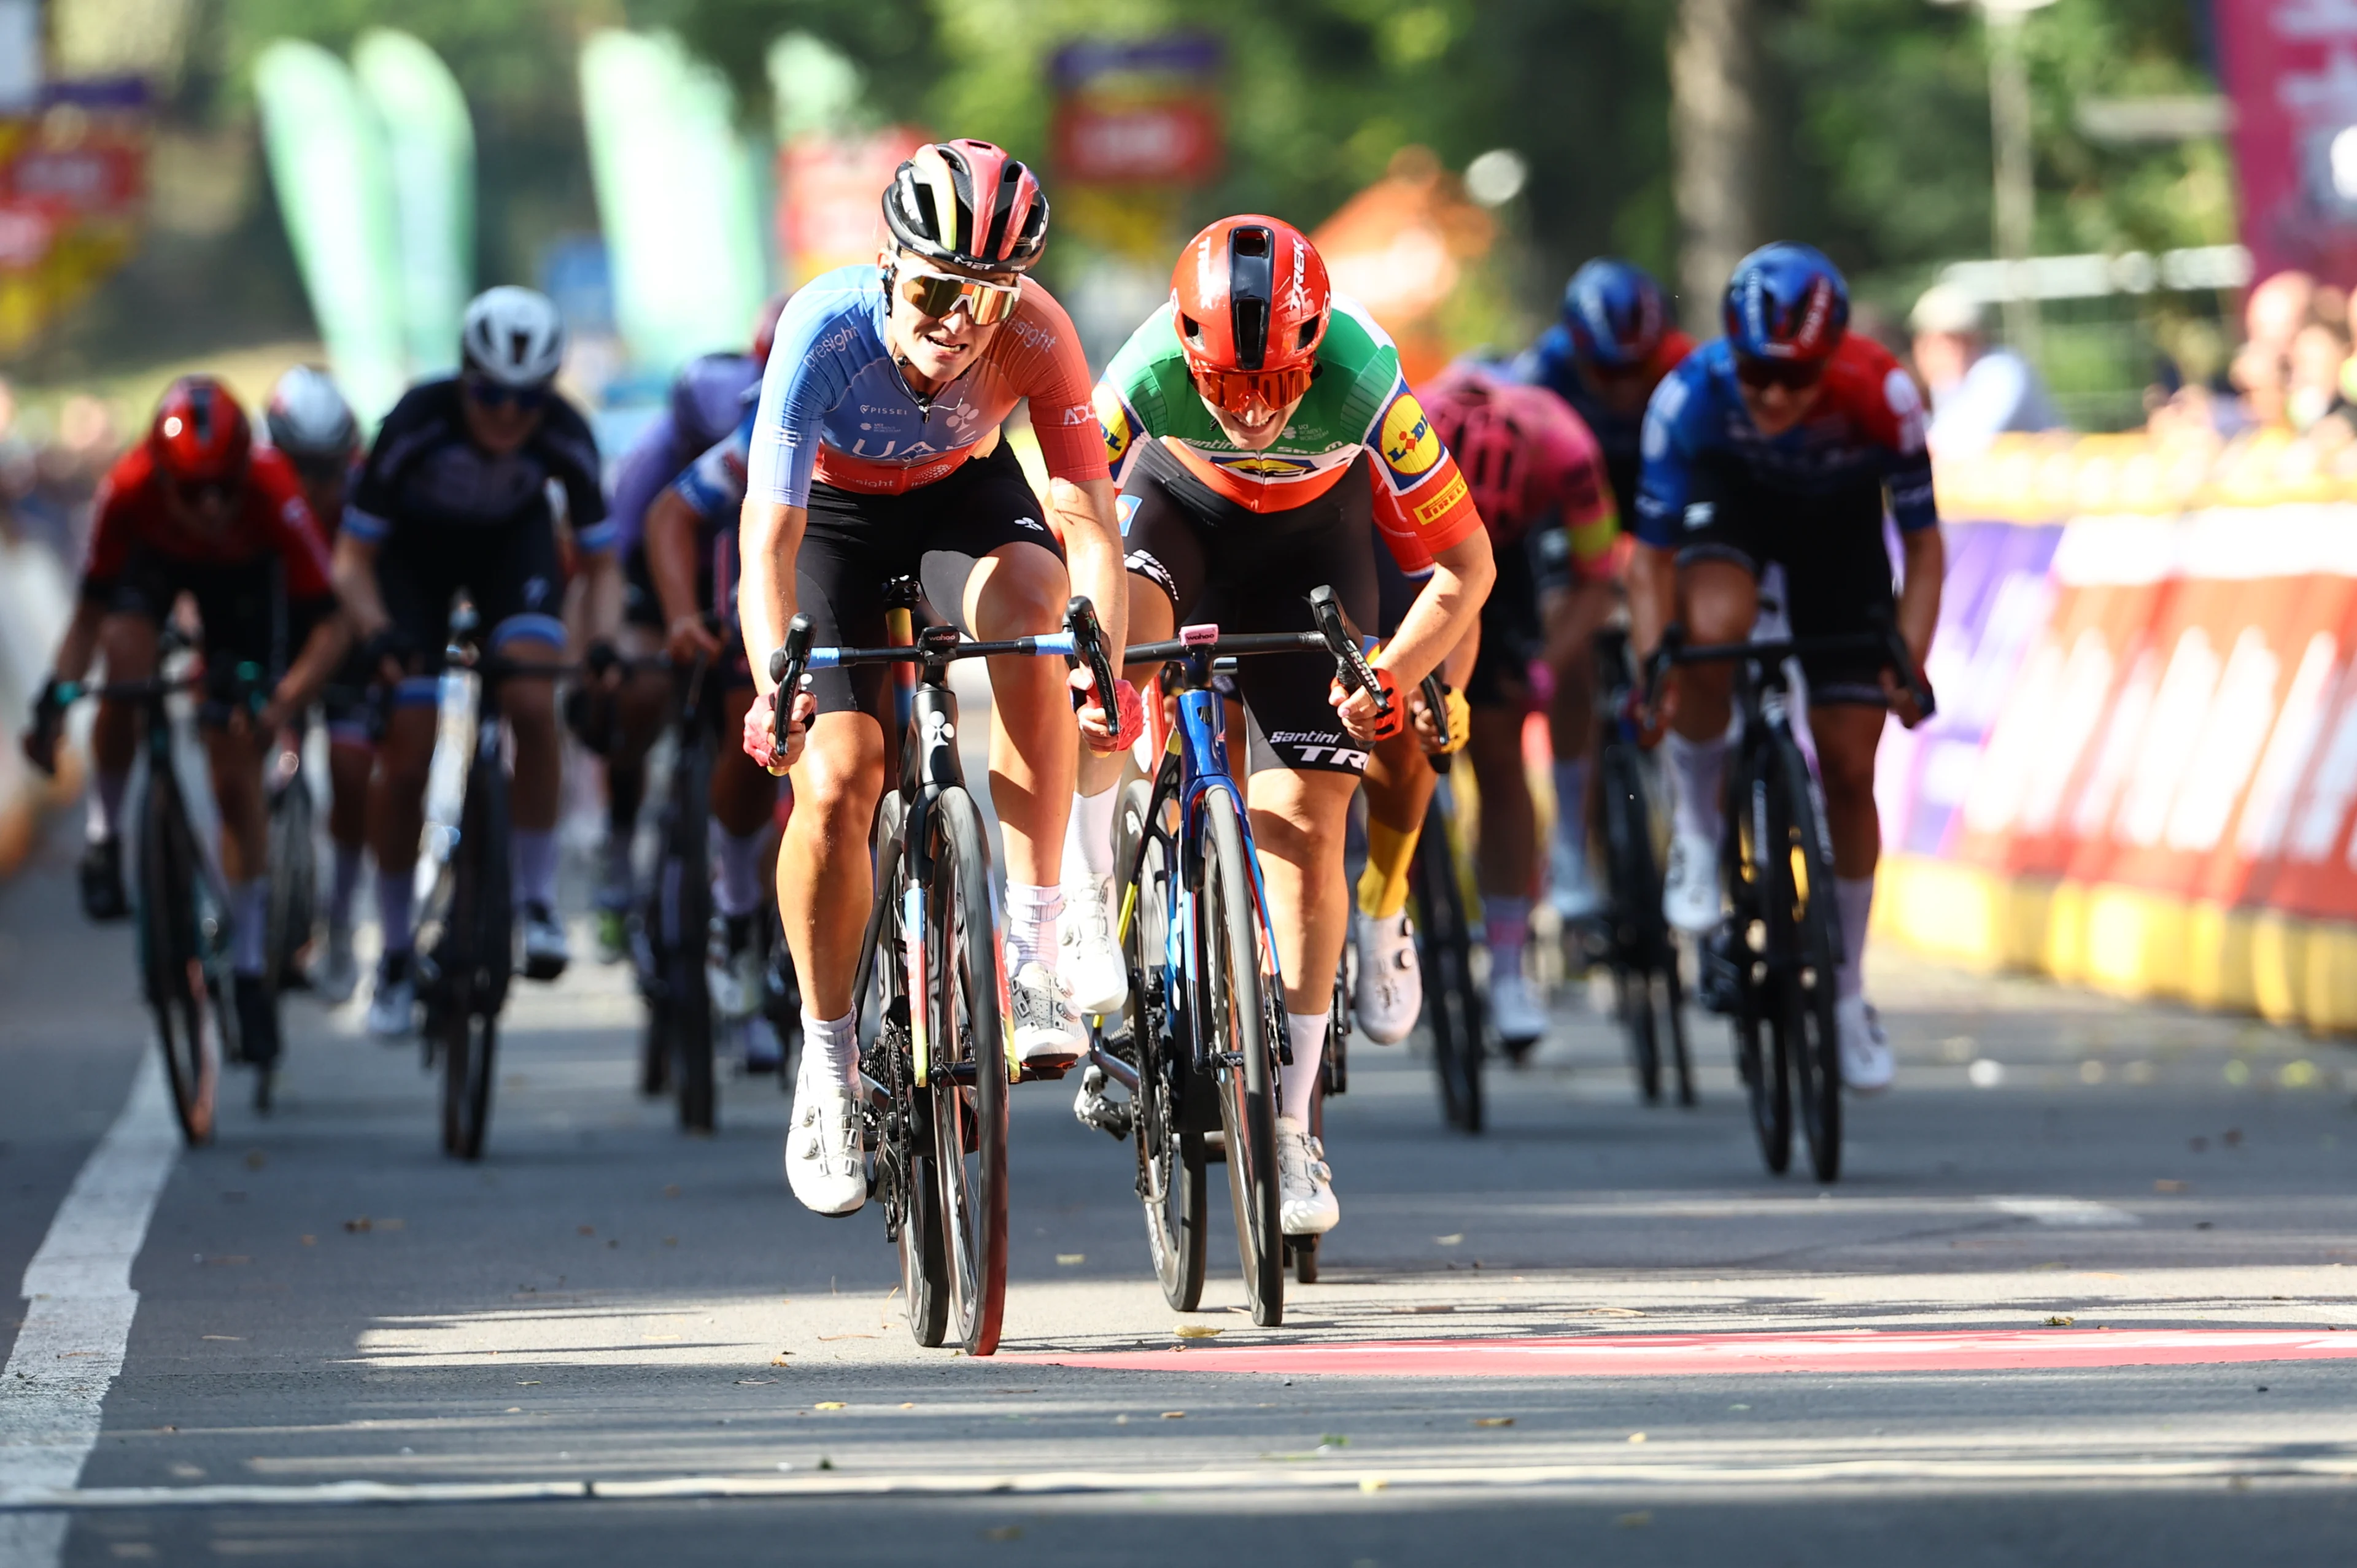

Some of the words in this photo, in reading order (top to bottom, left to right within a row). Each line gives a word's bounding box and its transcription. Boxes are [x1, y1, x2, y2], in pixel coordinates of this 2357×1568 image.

[953, 257, 994, 271] MET
[1290, 238, 1305, 311] TREK
[803, 323, 859, 373] presight
[1269, 730, 1342, 744] Santini
[1293, 744, 1370, 771] TR
